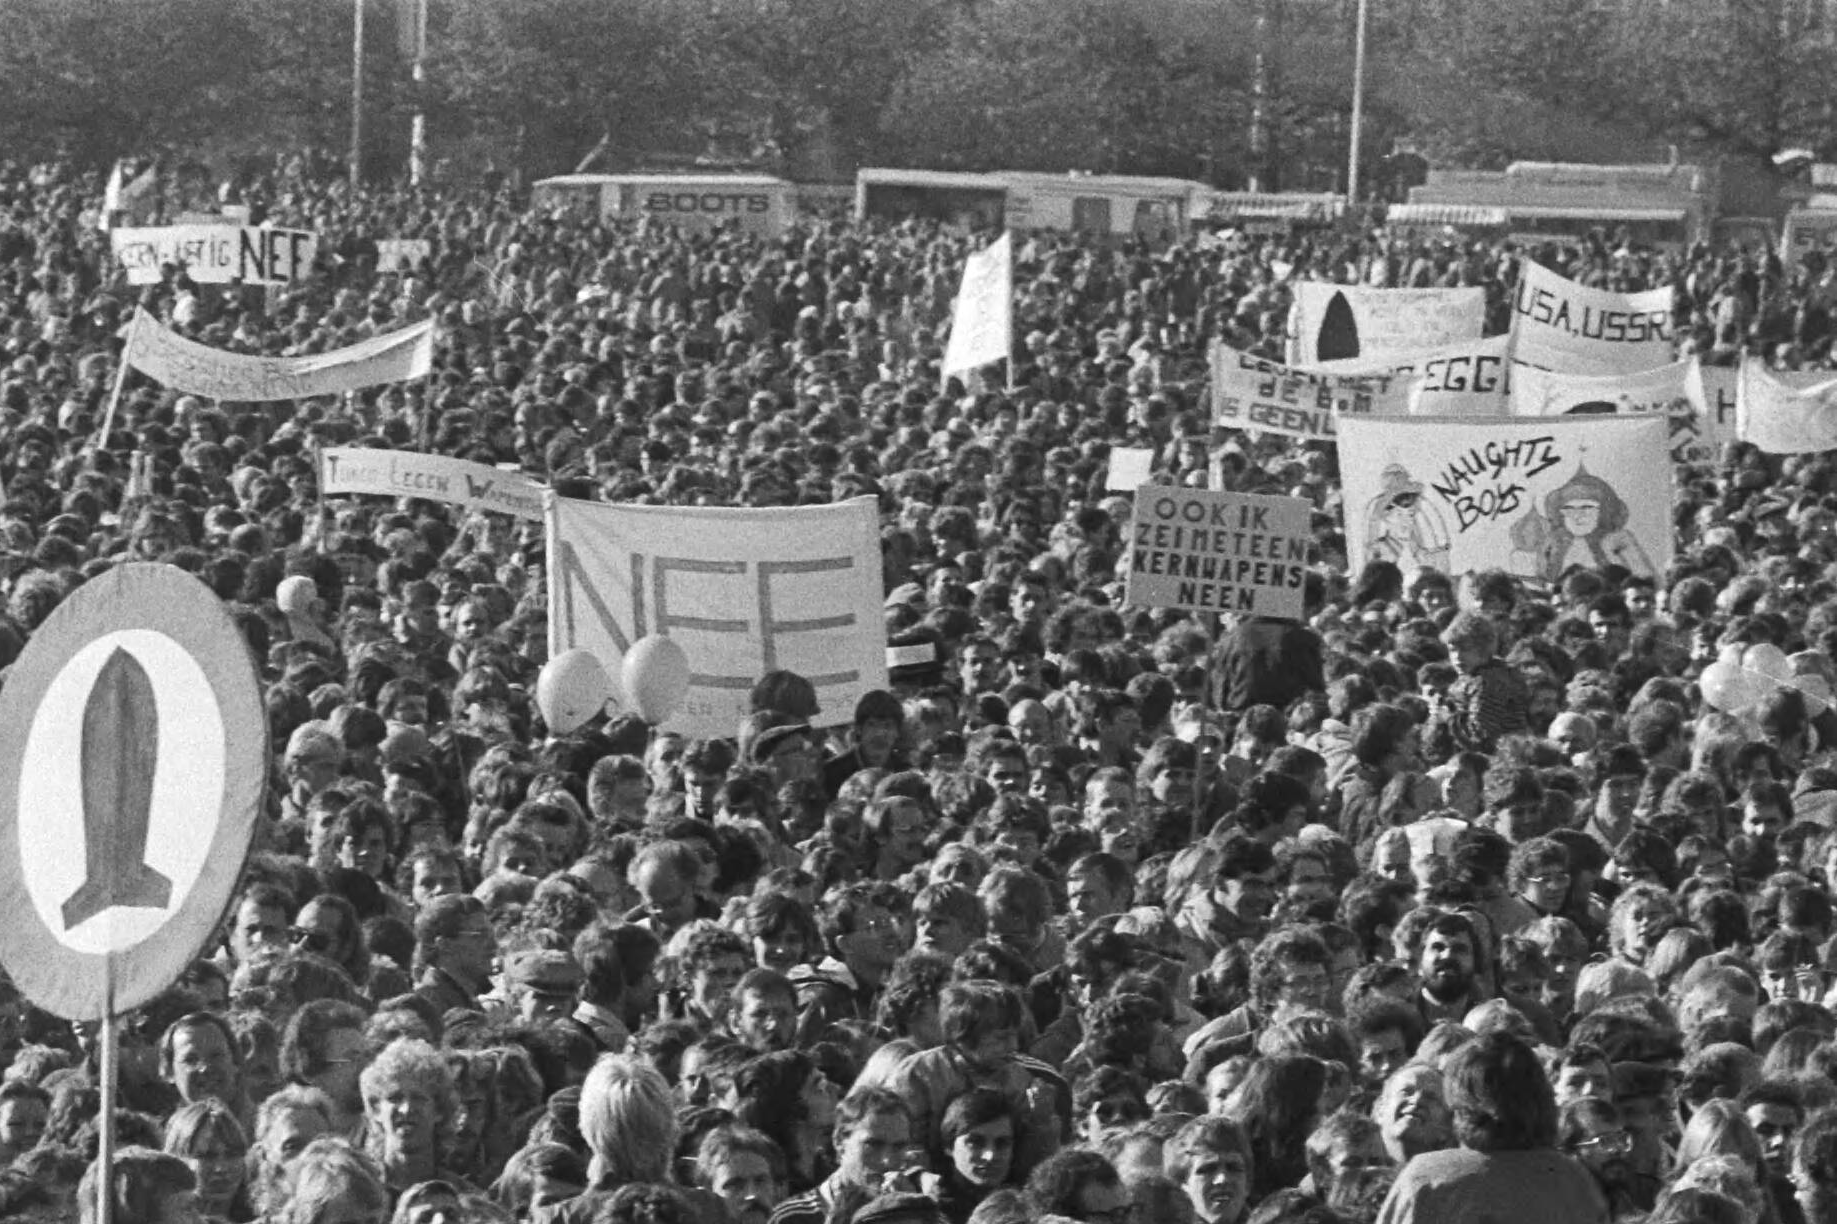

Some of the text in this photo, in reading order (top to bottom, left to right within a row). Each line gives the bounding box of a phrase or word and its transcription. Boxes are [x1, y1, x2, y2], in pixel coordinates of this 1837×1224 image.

[1583, 306, 1670, 342] USSR
[1155, 498, 1270, 531] OOK IK
[1136, 522, 1308, 562] ZEI METEEN
[1132, 553, 1304, 589] KERNWAPENS
[1178, 581, 1257, 612] NEEN
[560, 540, 860, 690] NEE
